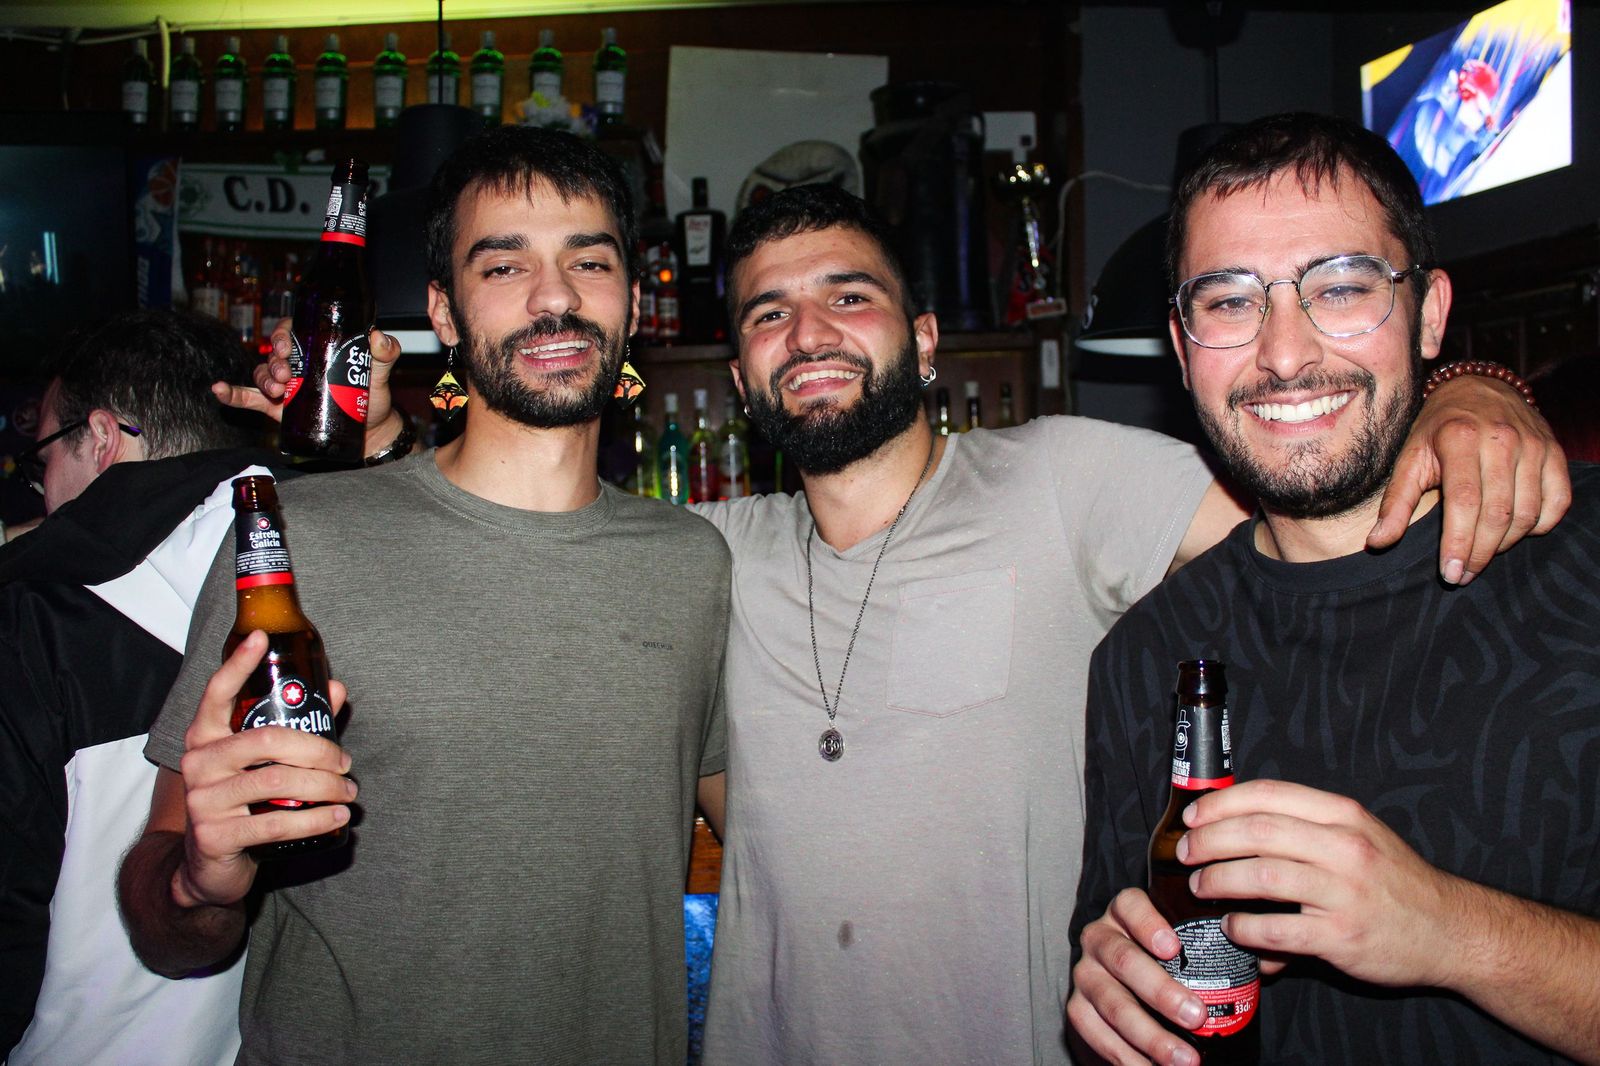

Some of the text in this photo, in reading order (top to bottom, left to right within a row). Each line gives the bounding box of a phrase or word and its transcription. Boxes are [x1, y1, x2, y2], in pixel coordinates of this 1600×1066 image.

[223, 175, 311, 214] C.D.
[347, 365, 370, 387] Gal
[249, 530, 280, 541] Estrella
[251, 539, 280, 549] Galicia
